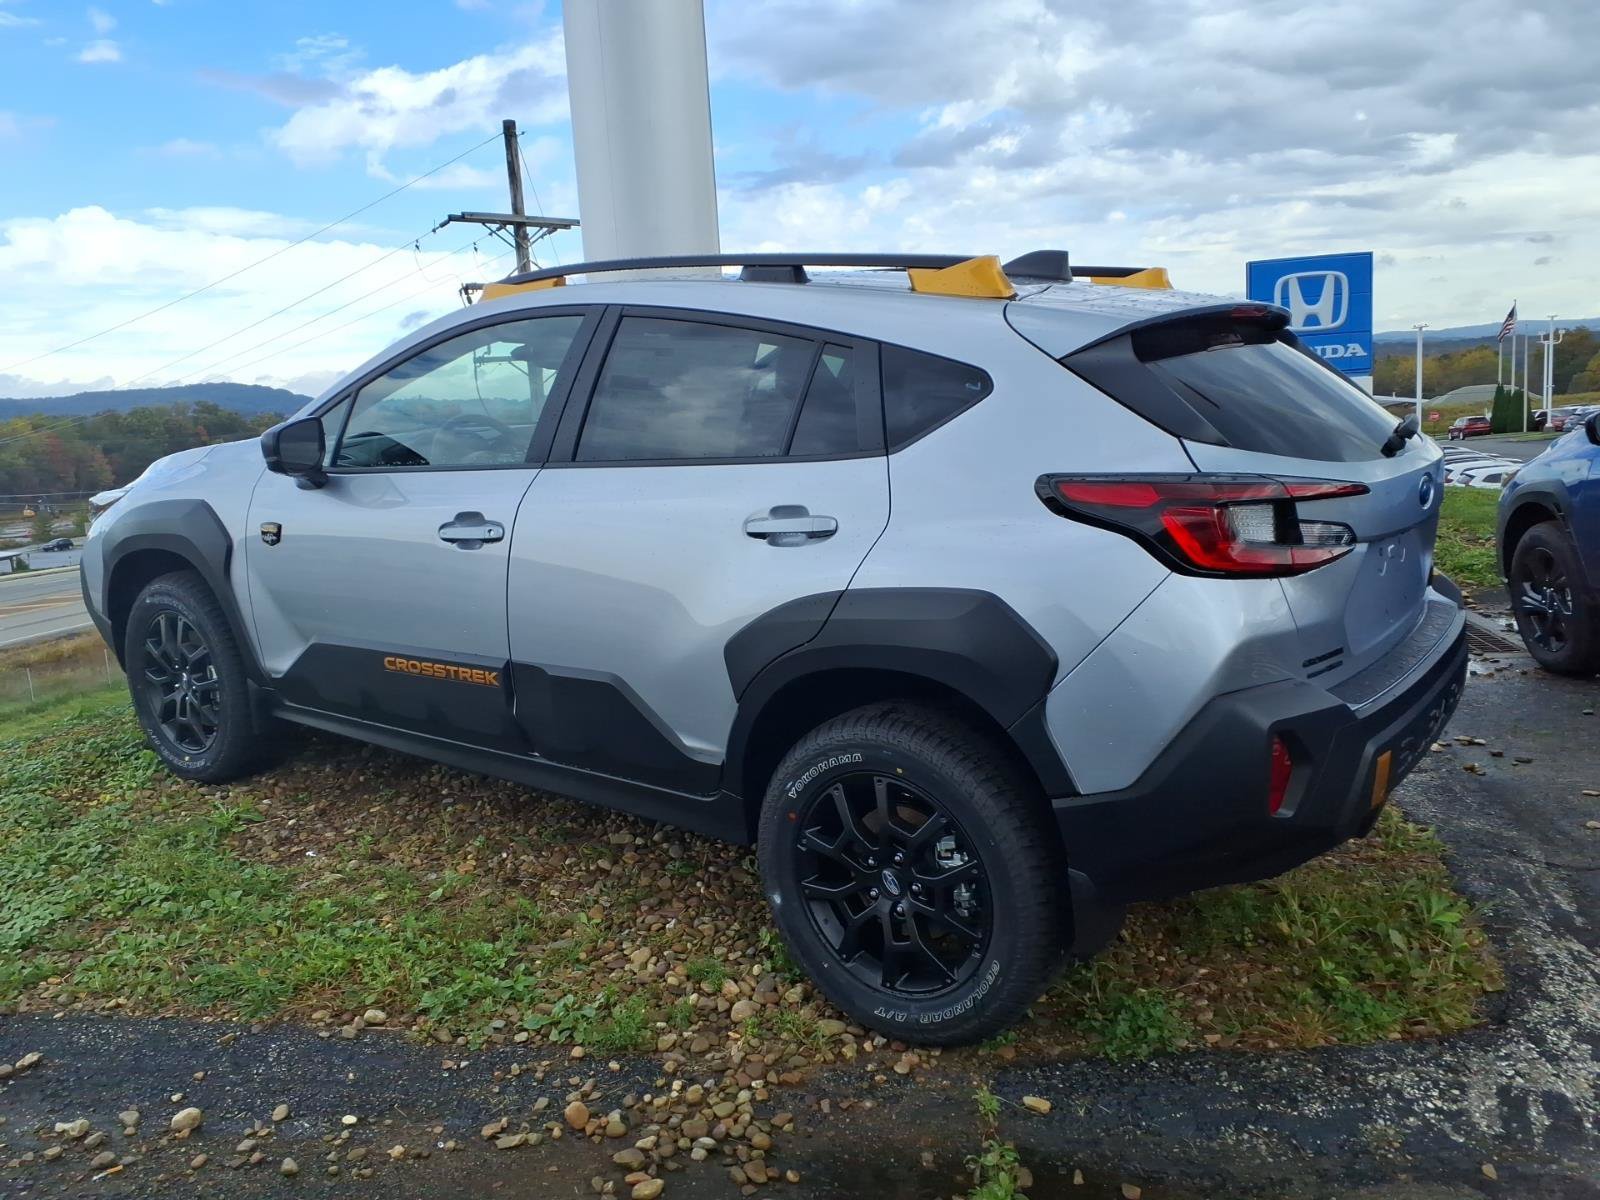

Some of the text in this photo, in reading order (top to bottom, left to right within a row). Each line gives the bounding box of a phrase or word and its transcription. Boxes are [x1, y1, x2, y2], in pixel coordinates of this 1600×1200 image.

[383, 656, 499, 686] CROSSTREK
[788, 753, 863, 799] YOKOHAMA
[874, 960, 1000, 1023] GEOLANDAR A/T
